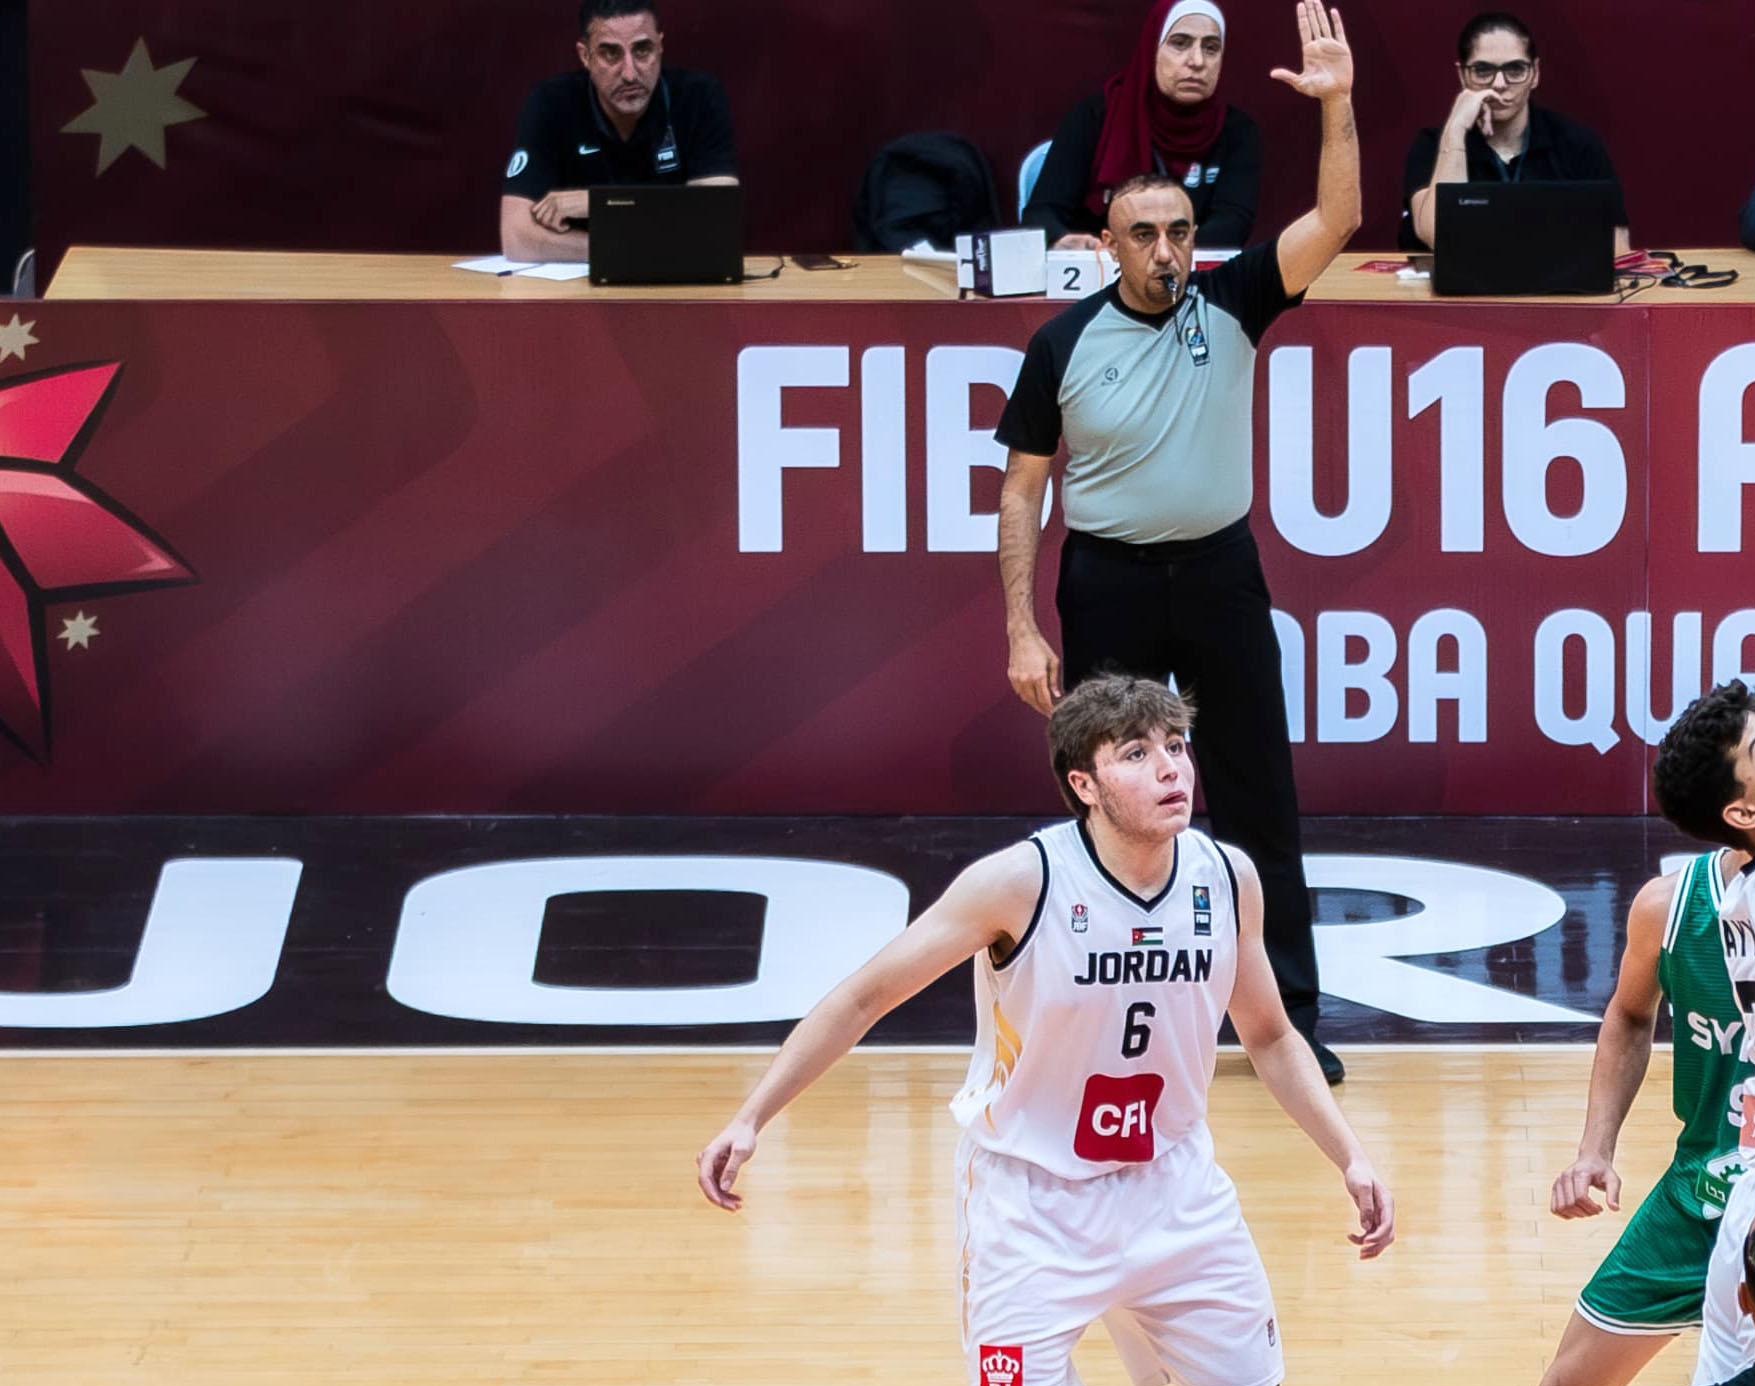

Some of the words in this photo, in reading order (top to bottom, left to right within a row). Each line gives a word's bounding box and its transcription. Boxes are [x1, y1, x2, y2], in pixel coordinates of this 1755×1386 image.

[1063, 267, 1081, 291] 2
[737, 345, 1067, 553] FIB
[1268, 342, 1627, 557] U16
[1074, 948, 1212, 985] JORDAN
[1121, 1001, 1156, 1059] 6
[1092, 1100, 1146, 1138] CFI
